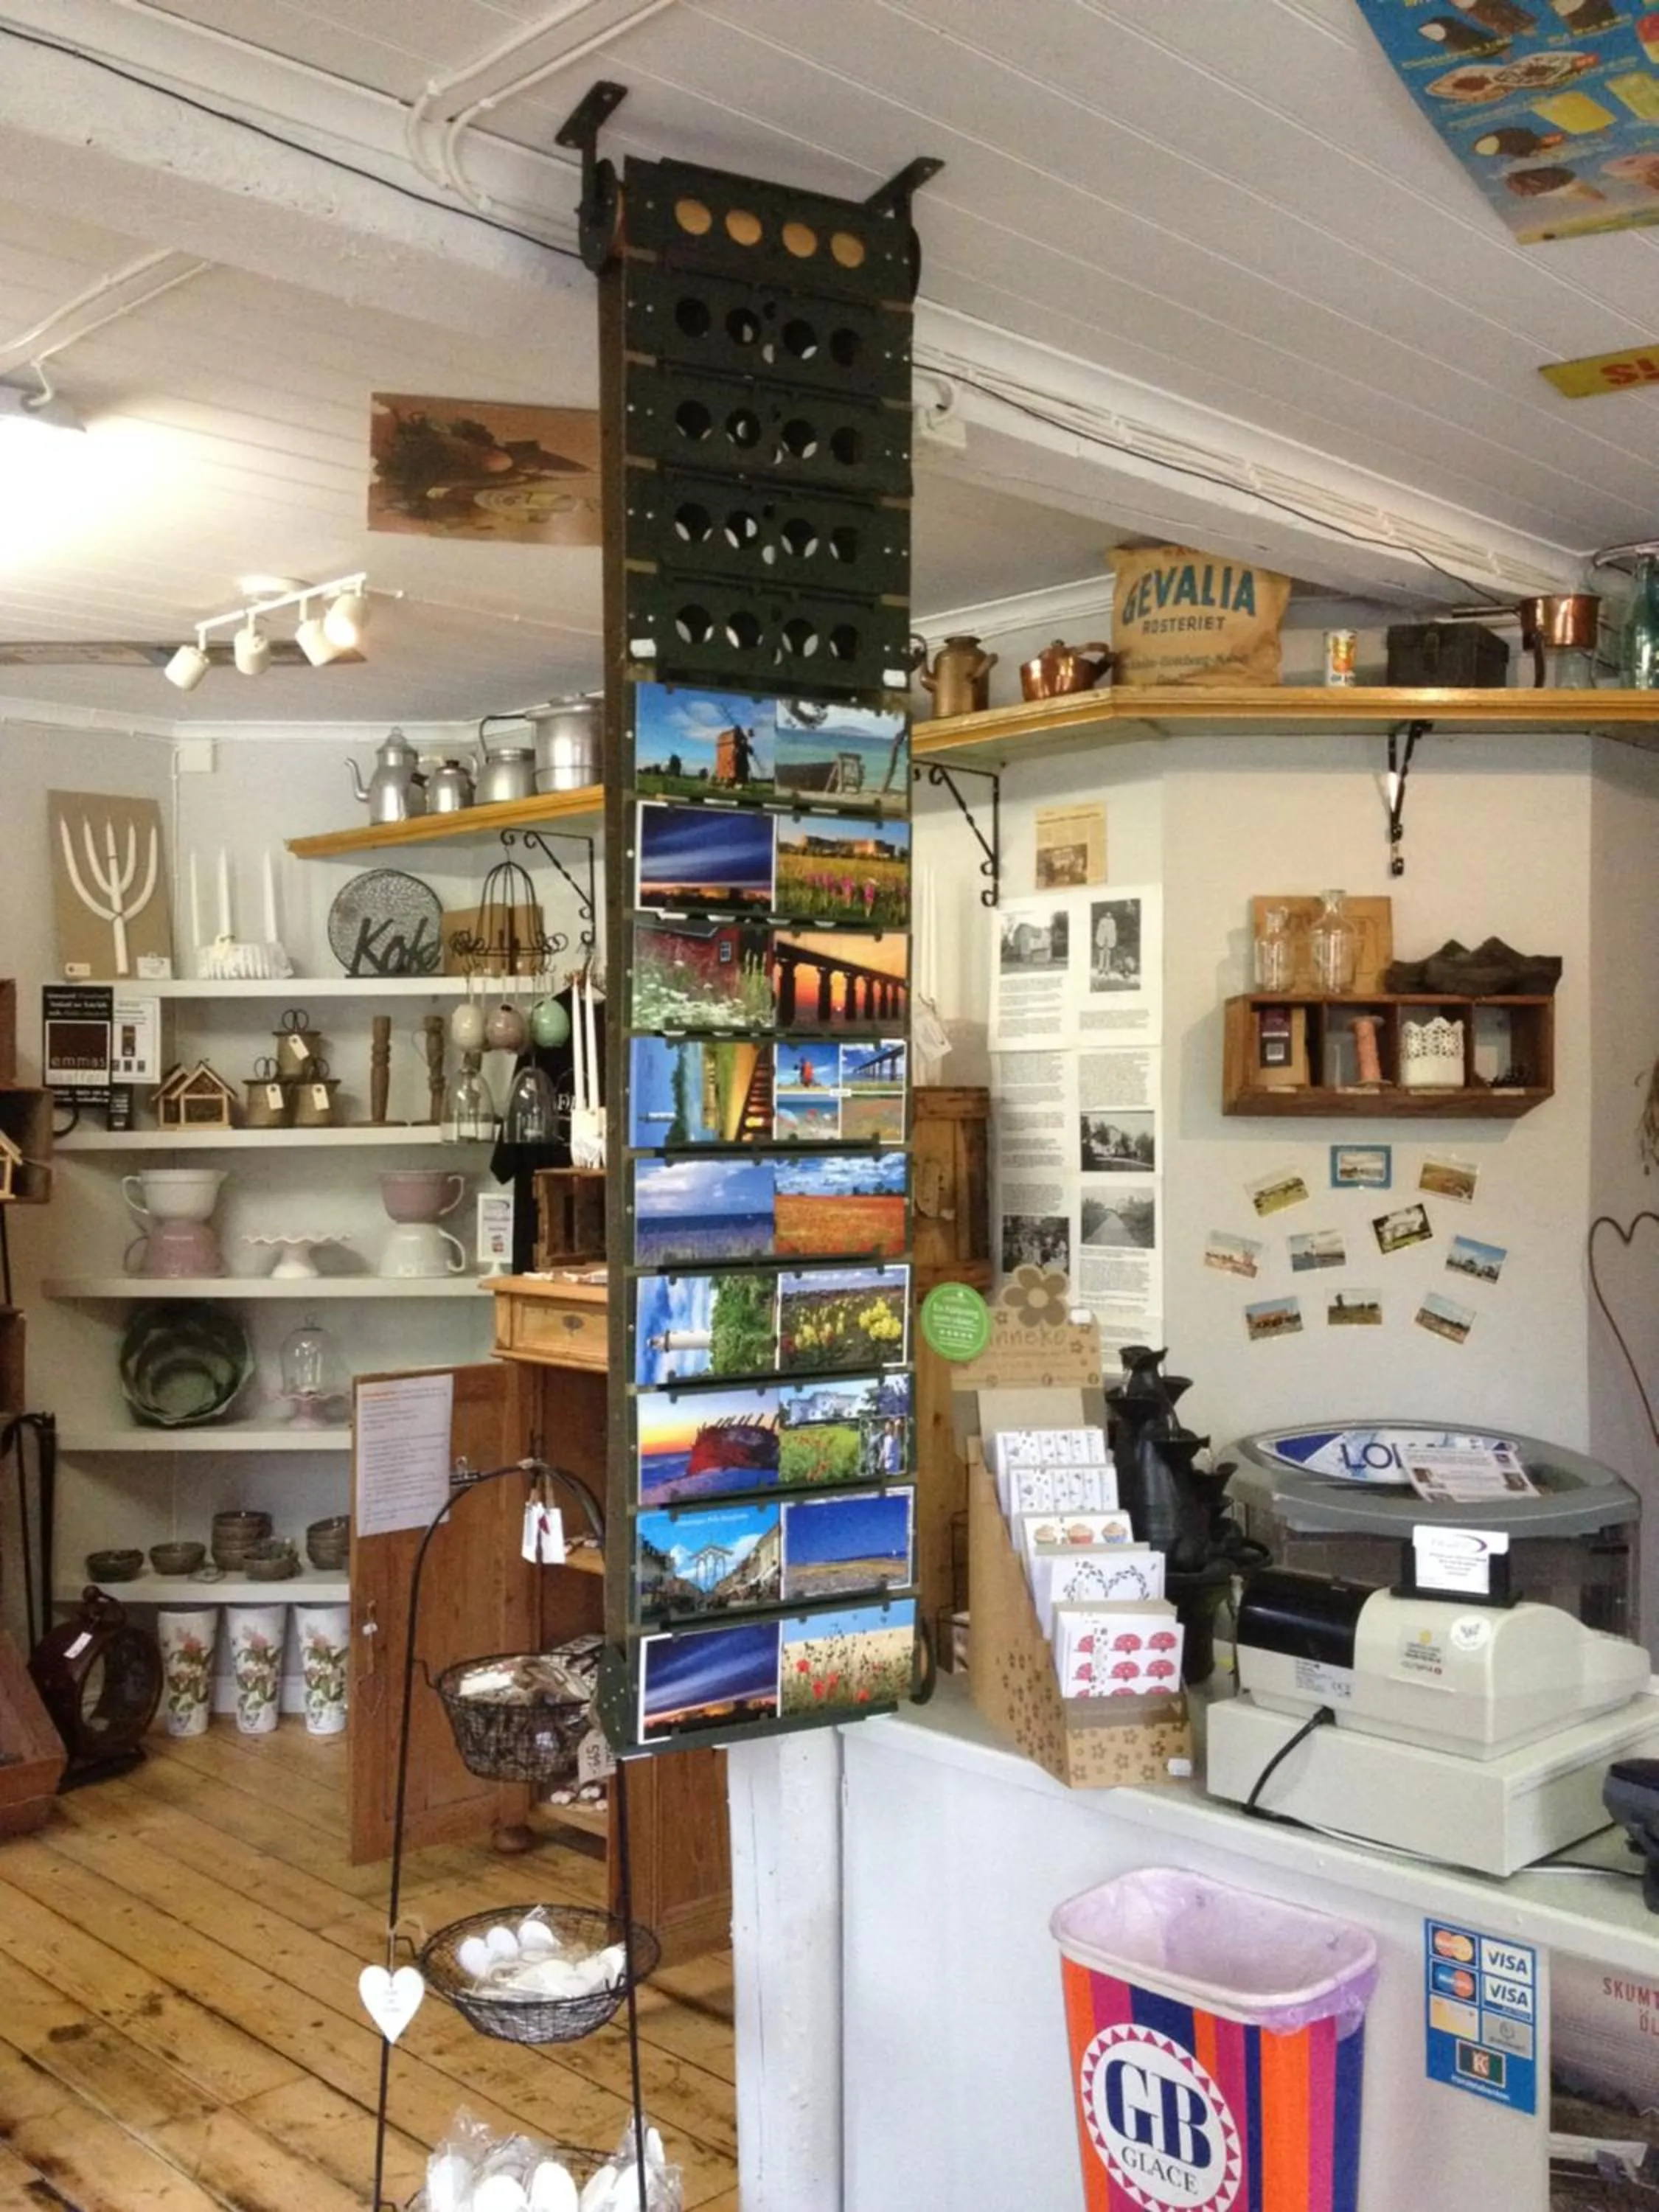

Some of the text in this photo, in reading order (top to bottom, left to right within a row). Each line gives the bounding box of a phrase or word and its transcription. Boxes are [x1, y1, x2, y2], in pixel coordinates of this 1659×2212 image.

[1121, 565, 1256, 625] GEVALIA
[1142, 616, 1225, 635] ROSTERIET
[1487, 1950, 1528, 1975] VISA
[1489, 1983, 1529, 2007] VISA
[1105, 2059, 1211, 2169] GB
[1121, 2145, 1199, 2194] GLACE
